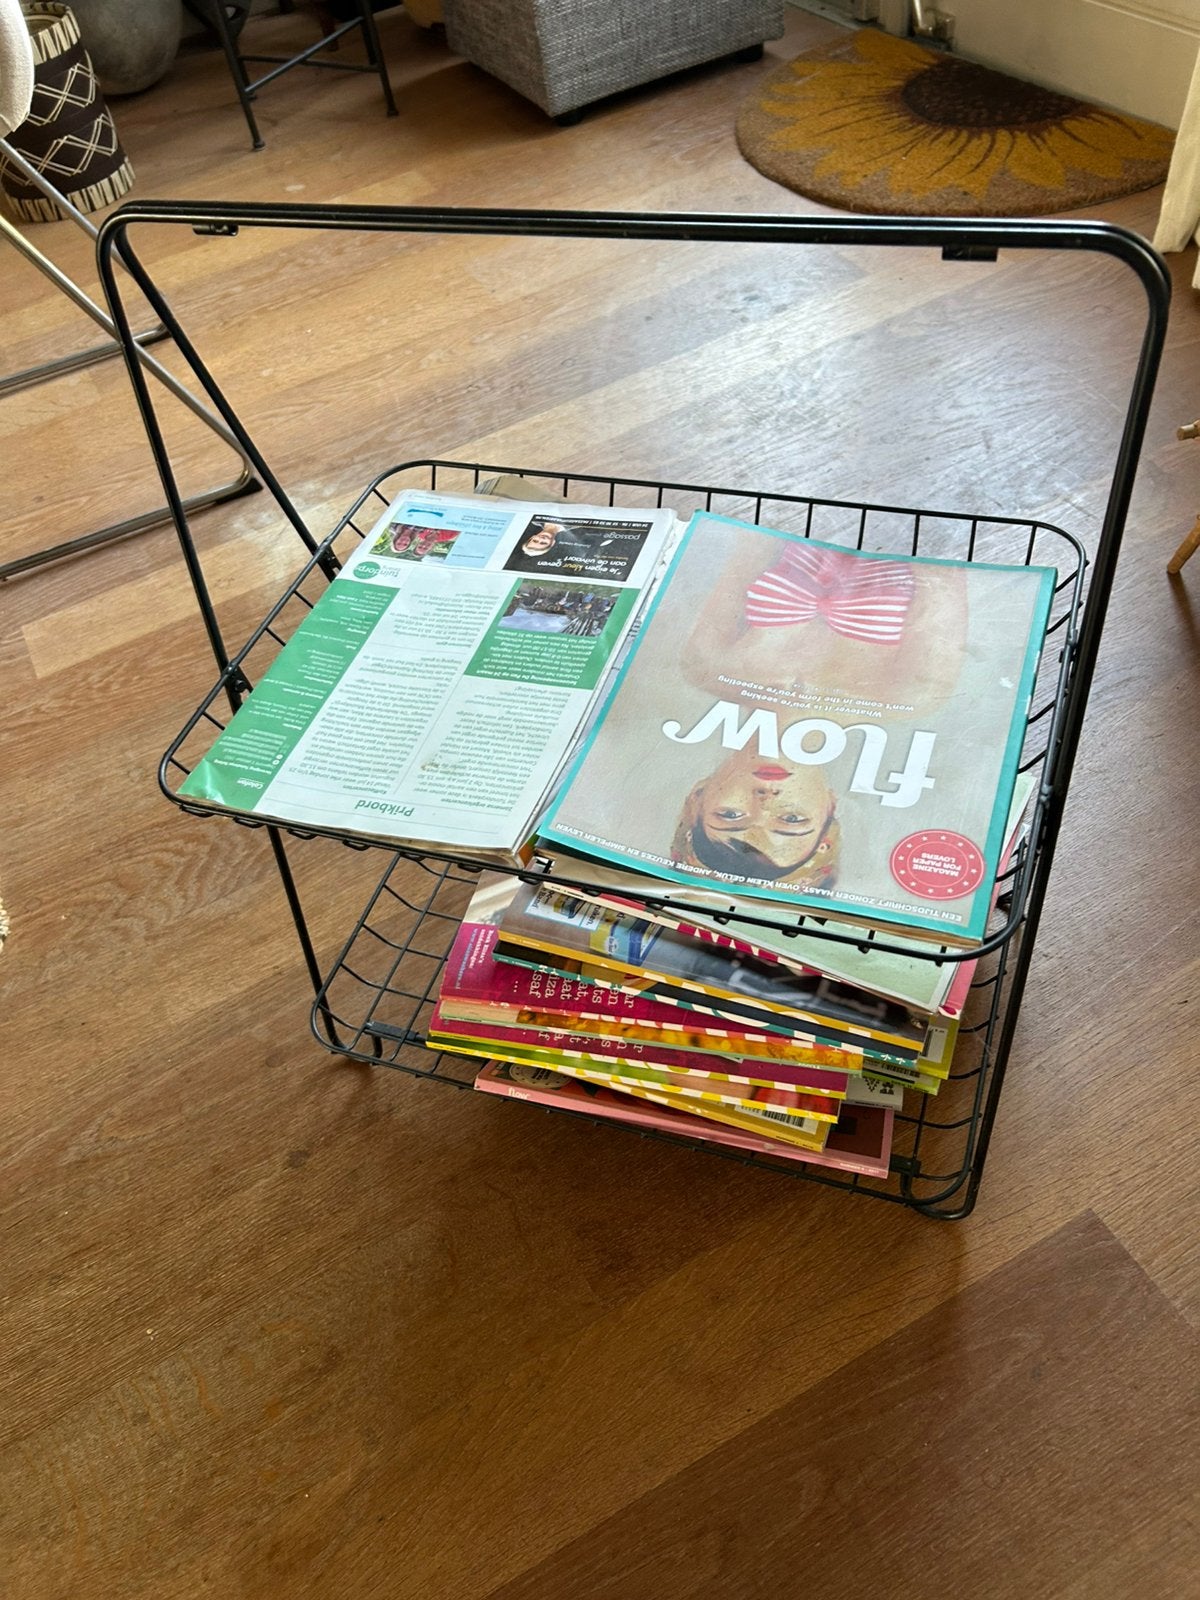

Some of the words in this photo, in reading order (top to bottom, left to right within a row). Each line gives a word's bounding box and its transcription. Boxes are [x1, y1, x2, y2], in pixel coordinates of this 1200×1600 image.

[603, 531, 641, 540] passage
[537, 559, 561, 567] geven
[563, 563, 583, 571] kleur
[585, 564, 608, 573] eigen
[717, 674, 763, 690] expecting
[739, 689, 778, 702] seeking
[765, 686, 796, 696] you're
[780, 697, 811, 706] you're
[798, 693, 821, 701] form
[834, 706, 882, 716] Whatever
[885, 703, 914, 711] won't
[662, 700, 938, 808] flow
[353, 798, 415, 817] Prikbord
[555, 823, 583, 837] LEVEN
[583, 833, 626, 850] SIMPELER
[626, 846, 639, 855] EN
[639, 851, 675, 865] KEUZES
[912, 857, 941, 867] PAPER
[920, 852, 955, 863] LOVERS
[676, 861, 711, 875] ANDERE
[911, 862, 958, 876] MAGAZINE
[943, 862, 961, 870] FOR
[711, 870, 745, 881] GELUK,
[747, 876, 773, 885] KLEIN
[774, 881, 800, 889] OVER
[835, 891, 874, 903] ZONDER
[877, 898, 939, 916] TIJDSCHRIFT
[941, 911, 961, 920] EEN
